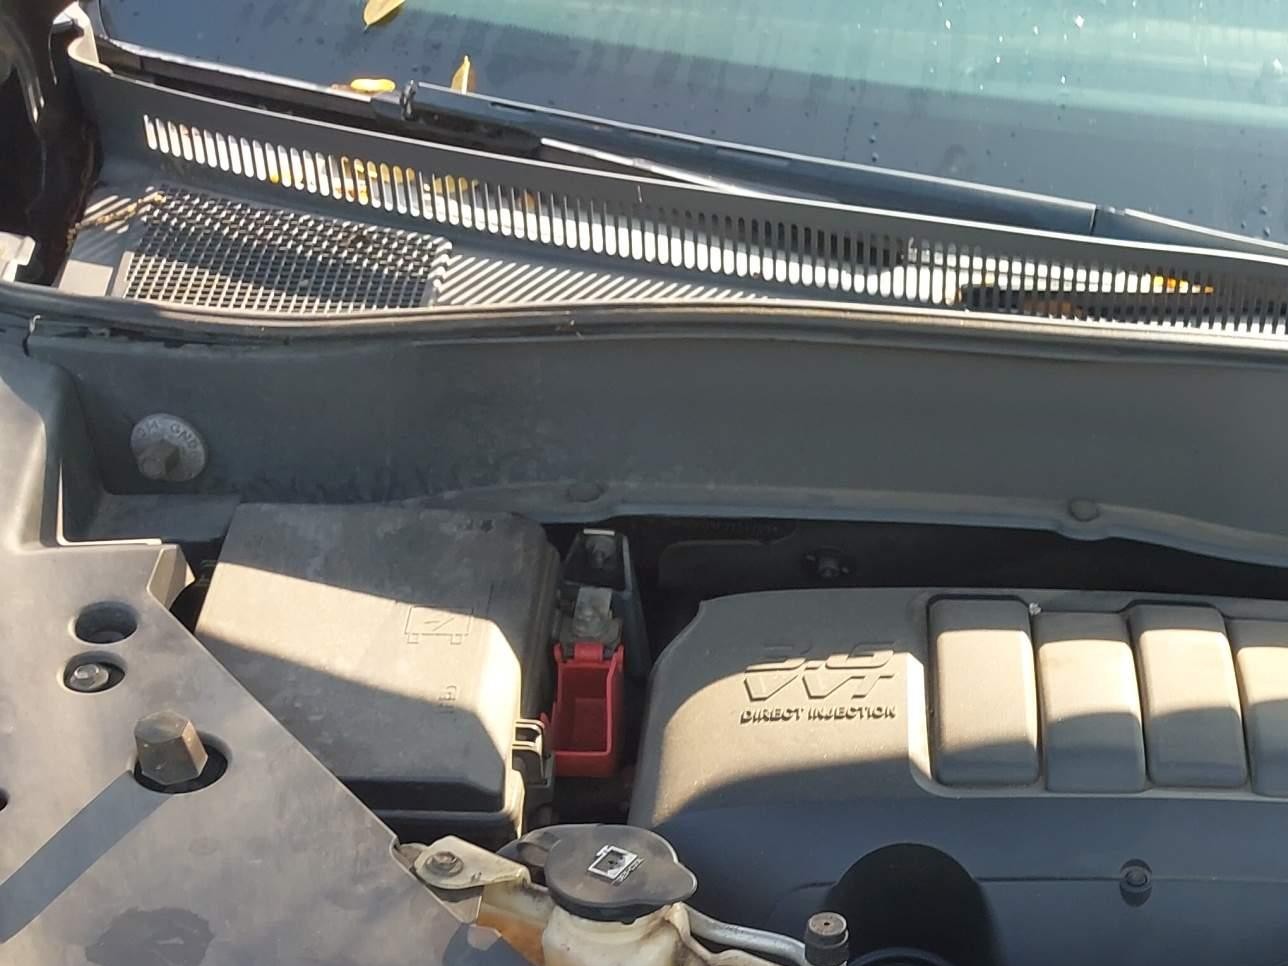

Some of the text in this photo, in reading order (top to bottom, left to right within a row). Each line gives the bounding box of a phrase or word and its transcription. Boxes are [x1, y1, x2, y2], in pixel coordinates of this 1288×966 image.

[744, 674, 895, 702] VVT
[740, 705, 896, 725] DIRECT INJECTION
